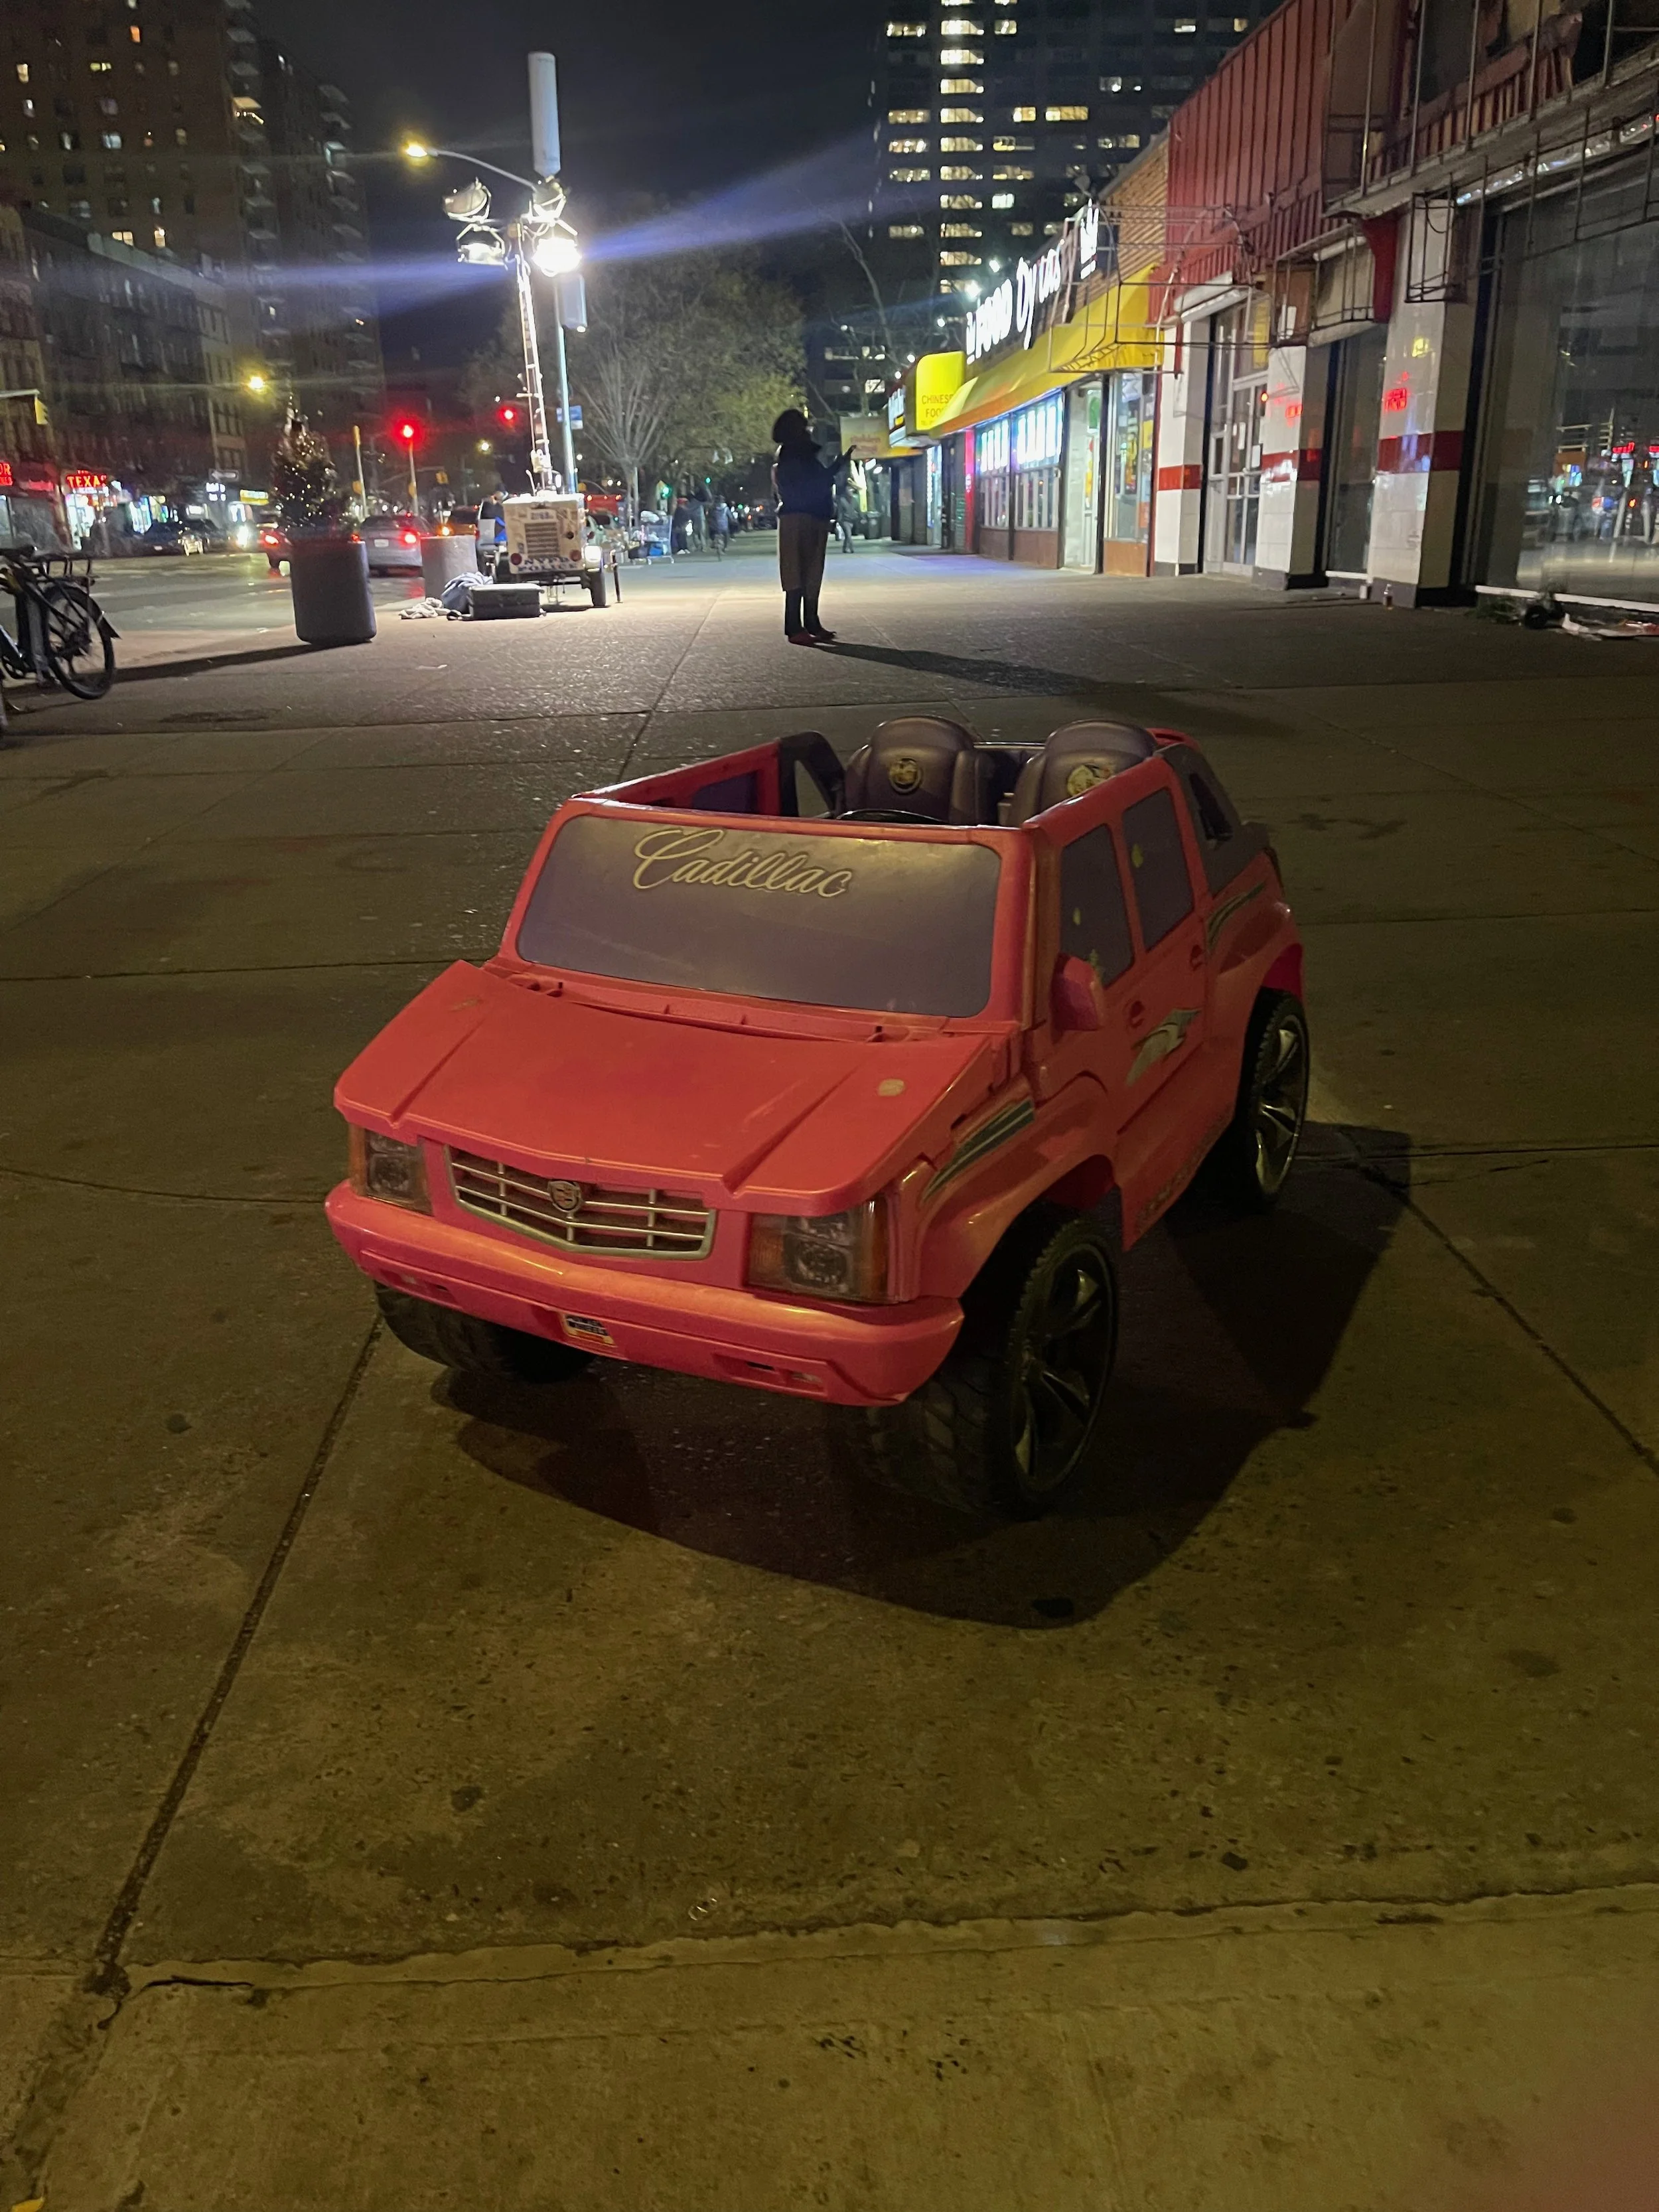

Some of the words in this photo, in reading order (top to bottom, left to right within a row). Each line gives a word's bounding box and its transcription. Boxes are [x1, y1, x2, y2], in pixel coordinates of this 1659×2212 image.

[975, 278, 1013, 358] FOOD
[926, 407, 944, 417] FOO
[632, 829, 852, 897] Cadillac
